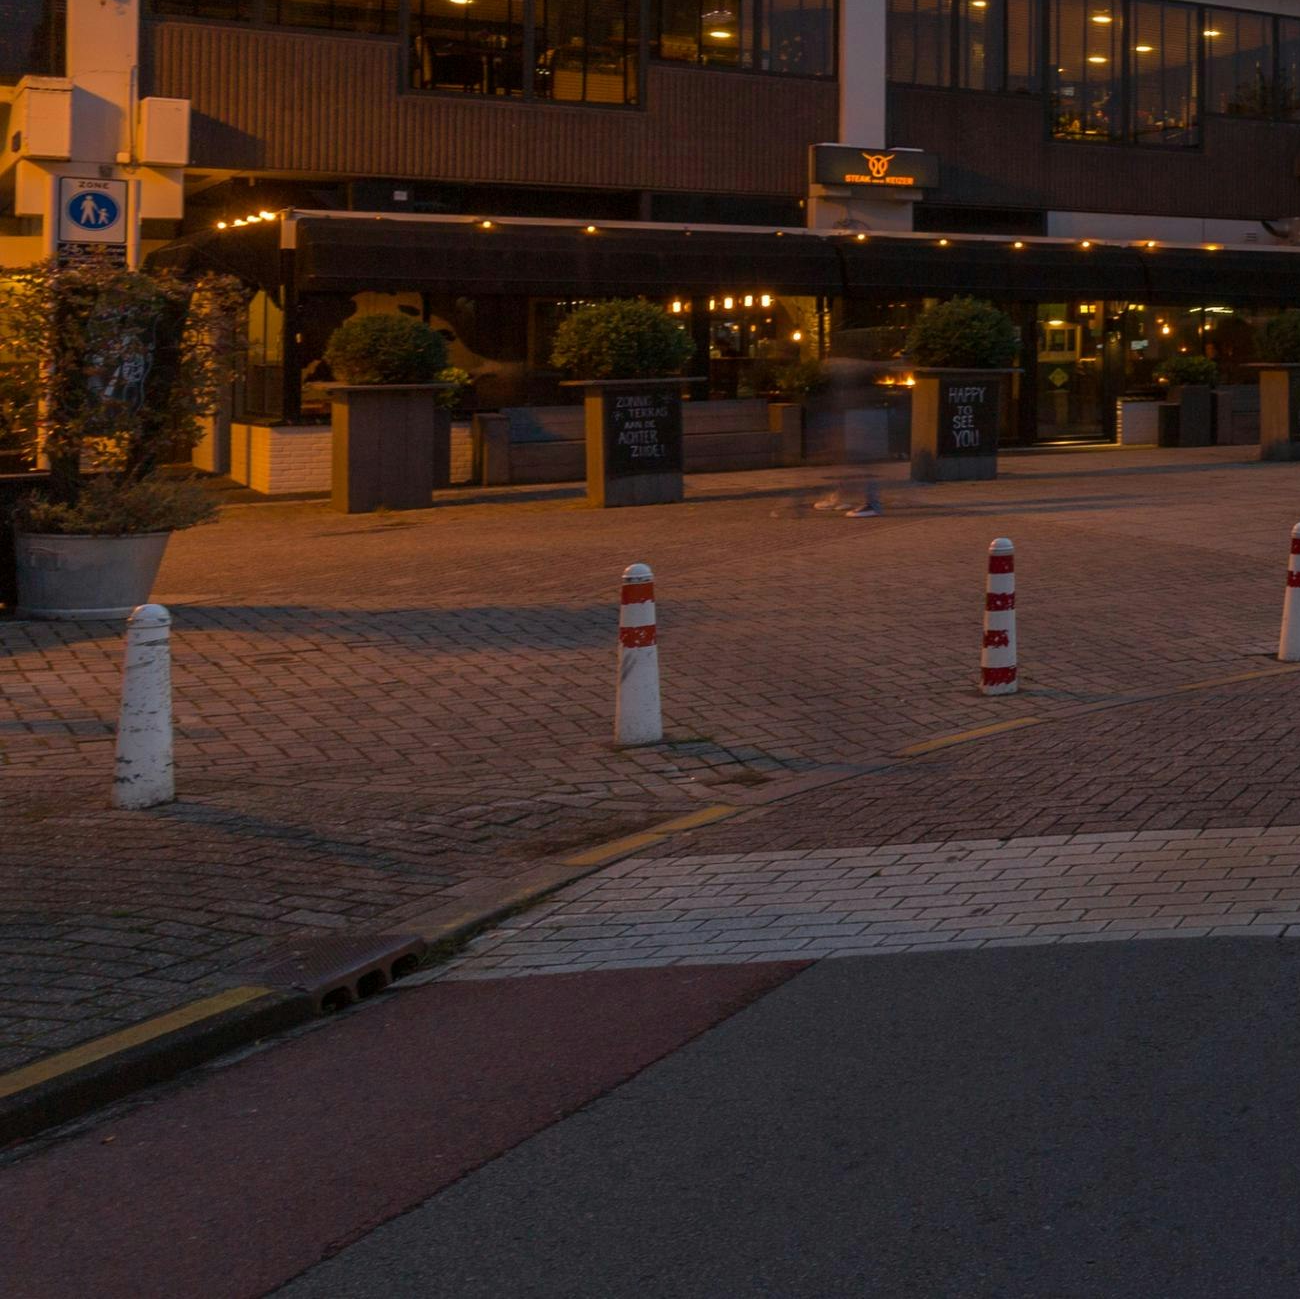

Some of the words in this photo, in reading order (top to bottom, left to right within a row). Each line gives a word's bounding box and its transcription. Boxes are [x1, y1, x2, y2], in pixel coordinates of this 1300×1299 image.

[78, 181, 110, 189] ZONE
[845, 174, 872, 184] STEAK
[949, 387, 986, 403] HAPPY
[957, 405, 973, 415] TO
[952, 415, 975, 429] SEE
[952, 429, 980, 448] YOU
